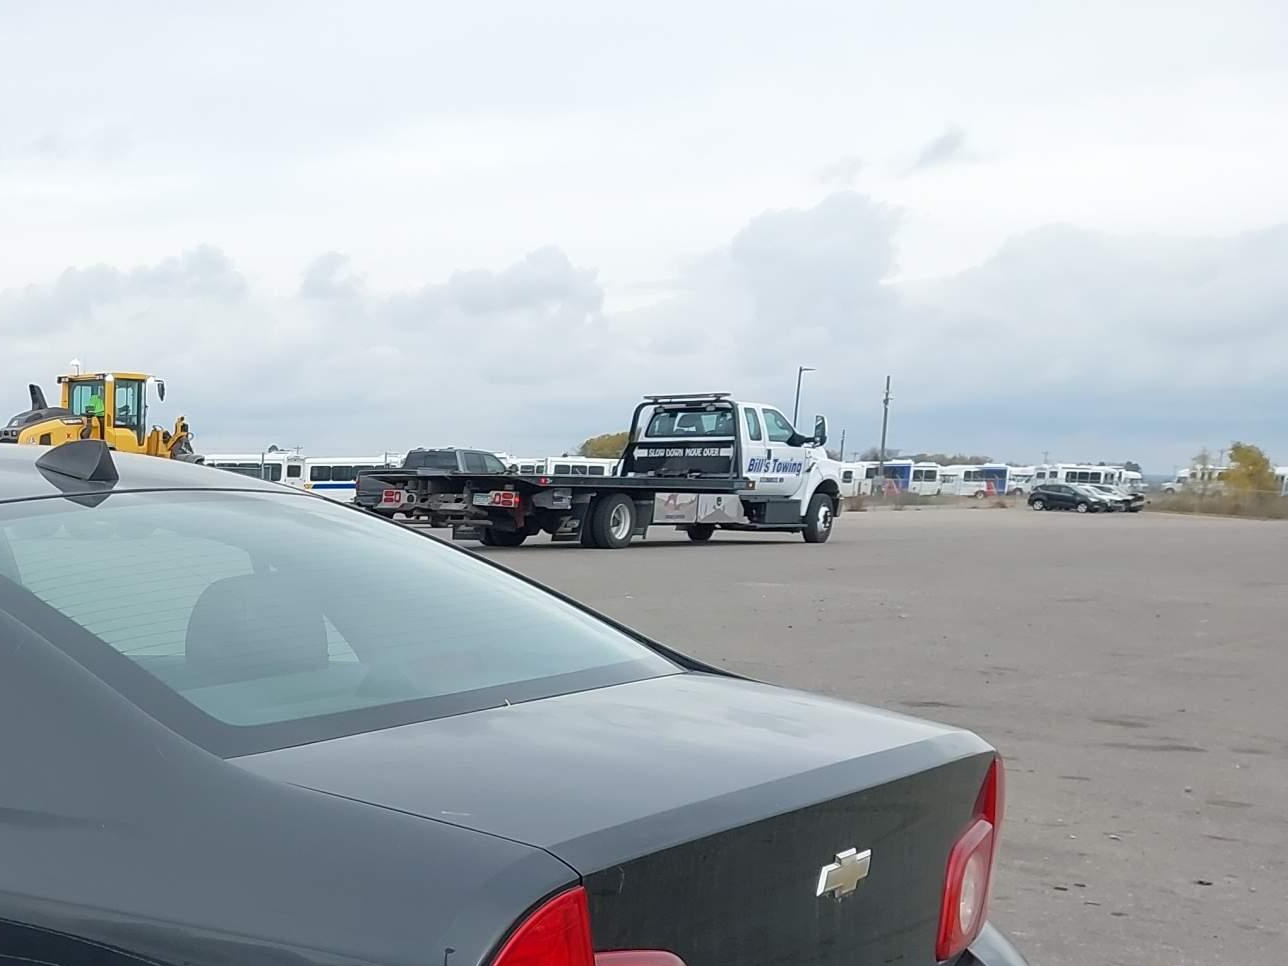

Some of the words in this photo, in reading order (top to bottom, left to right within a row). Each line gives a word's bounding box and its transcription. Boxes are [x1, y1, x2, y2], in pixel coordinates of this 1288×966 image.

[648, 448, 664, 457] SLOW
[665, 448, 684, 457] DOWN
[685, 447, 702, 456] MOVE
[702, 447, 719, 456] OVER
[747, 458, 770, 473] Bill's
[772, 458, 803, 477] Towing
